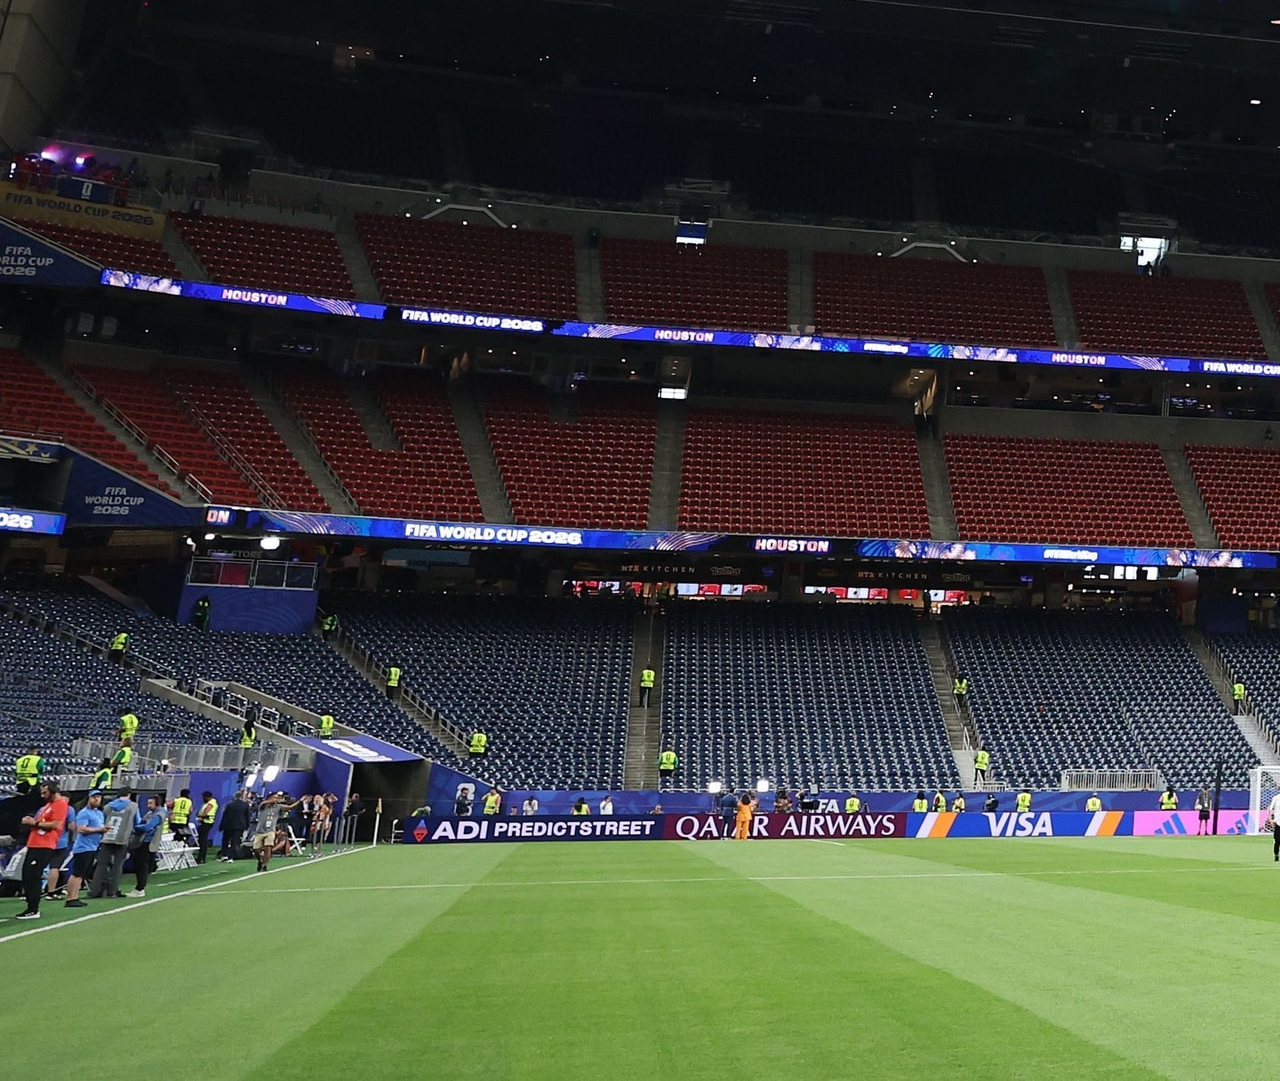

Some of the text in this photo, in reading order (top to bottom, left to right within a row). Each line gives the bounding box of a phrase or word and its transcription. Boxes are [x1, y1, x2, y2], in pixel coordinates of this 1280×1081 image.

[6, 193, 154, 226] FIFA WORLD CUP 2026
[5, 246, 32, 256] FIFA
[0, 256, 54, 267] RLD CUP
[0, 266, 36, 276] 026
[222, 289, 288, 306] HOUSTON
[402, 309, 543, 331] FIFA WORLD CUP 2026
[655, 329, 714, 342] HOUSTON
[1052, 353, 1106, 365] HOUSTON
[1203, 361, 1226, 372] FIFA
[1226, 363, 1263, 374] WORLD
[105, 487, 127, 496] FIFA
[85, 495, 145, 506] WORLD CUP
[93, 506, 130, 515] 2026
[405, 524, 582, 545] FIFA WORLD CUP 2026
[755, 539, 829, 552] HOUSTON
[643, 565, 695, 573] KITCHEN
[878, 572, 927, 580] KITCHEN
[803, 799, 839, 813] FA
[431, 820, 655, 840] ADI PREDICTSTREET
[675, 814, 896, 840] QAR AIRWAYS
[982, 811, 1054, 837] VISA
